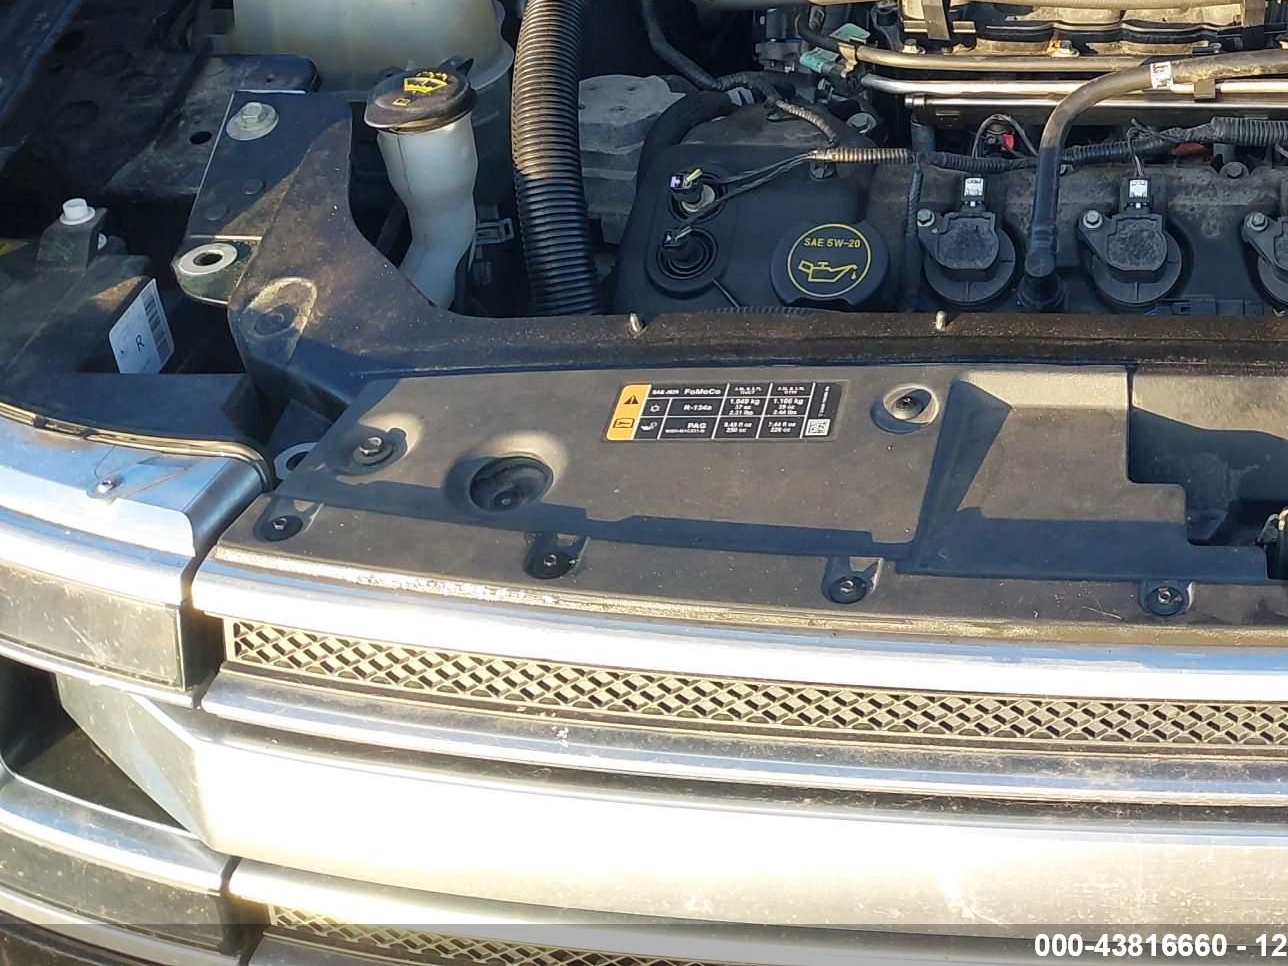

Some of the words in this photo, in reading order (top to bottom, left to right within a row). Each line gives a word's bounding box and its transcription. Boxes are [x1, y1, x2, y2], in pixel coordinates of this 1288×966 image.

[804, 238, 824, 247] SAE
[826, 238, 860, 248] 5W-20
[135, 334, 145, 353] R
[750, 398, 761, 406] kg
